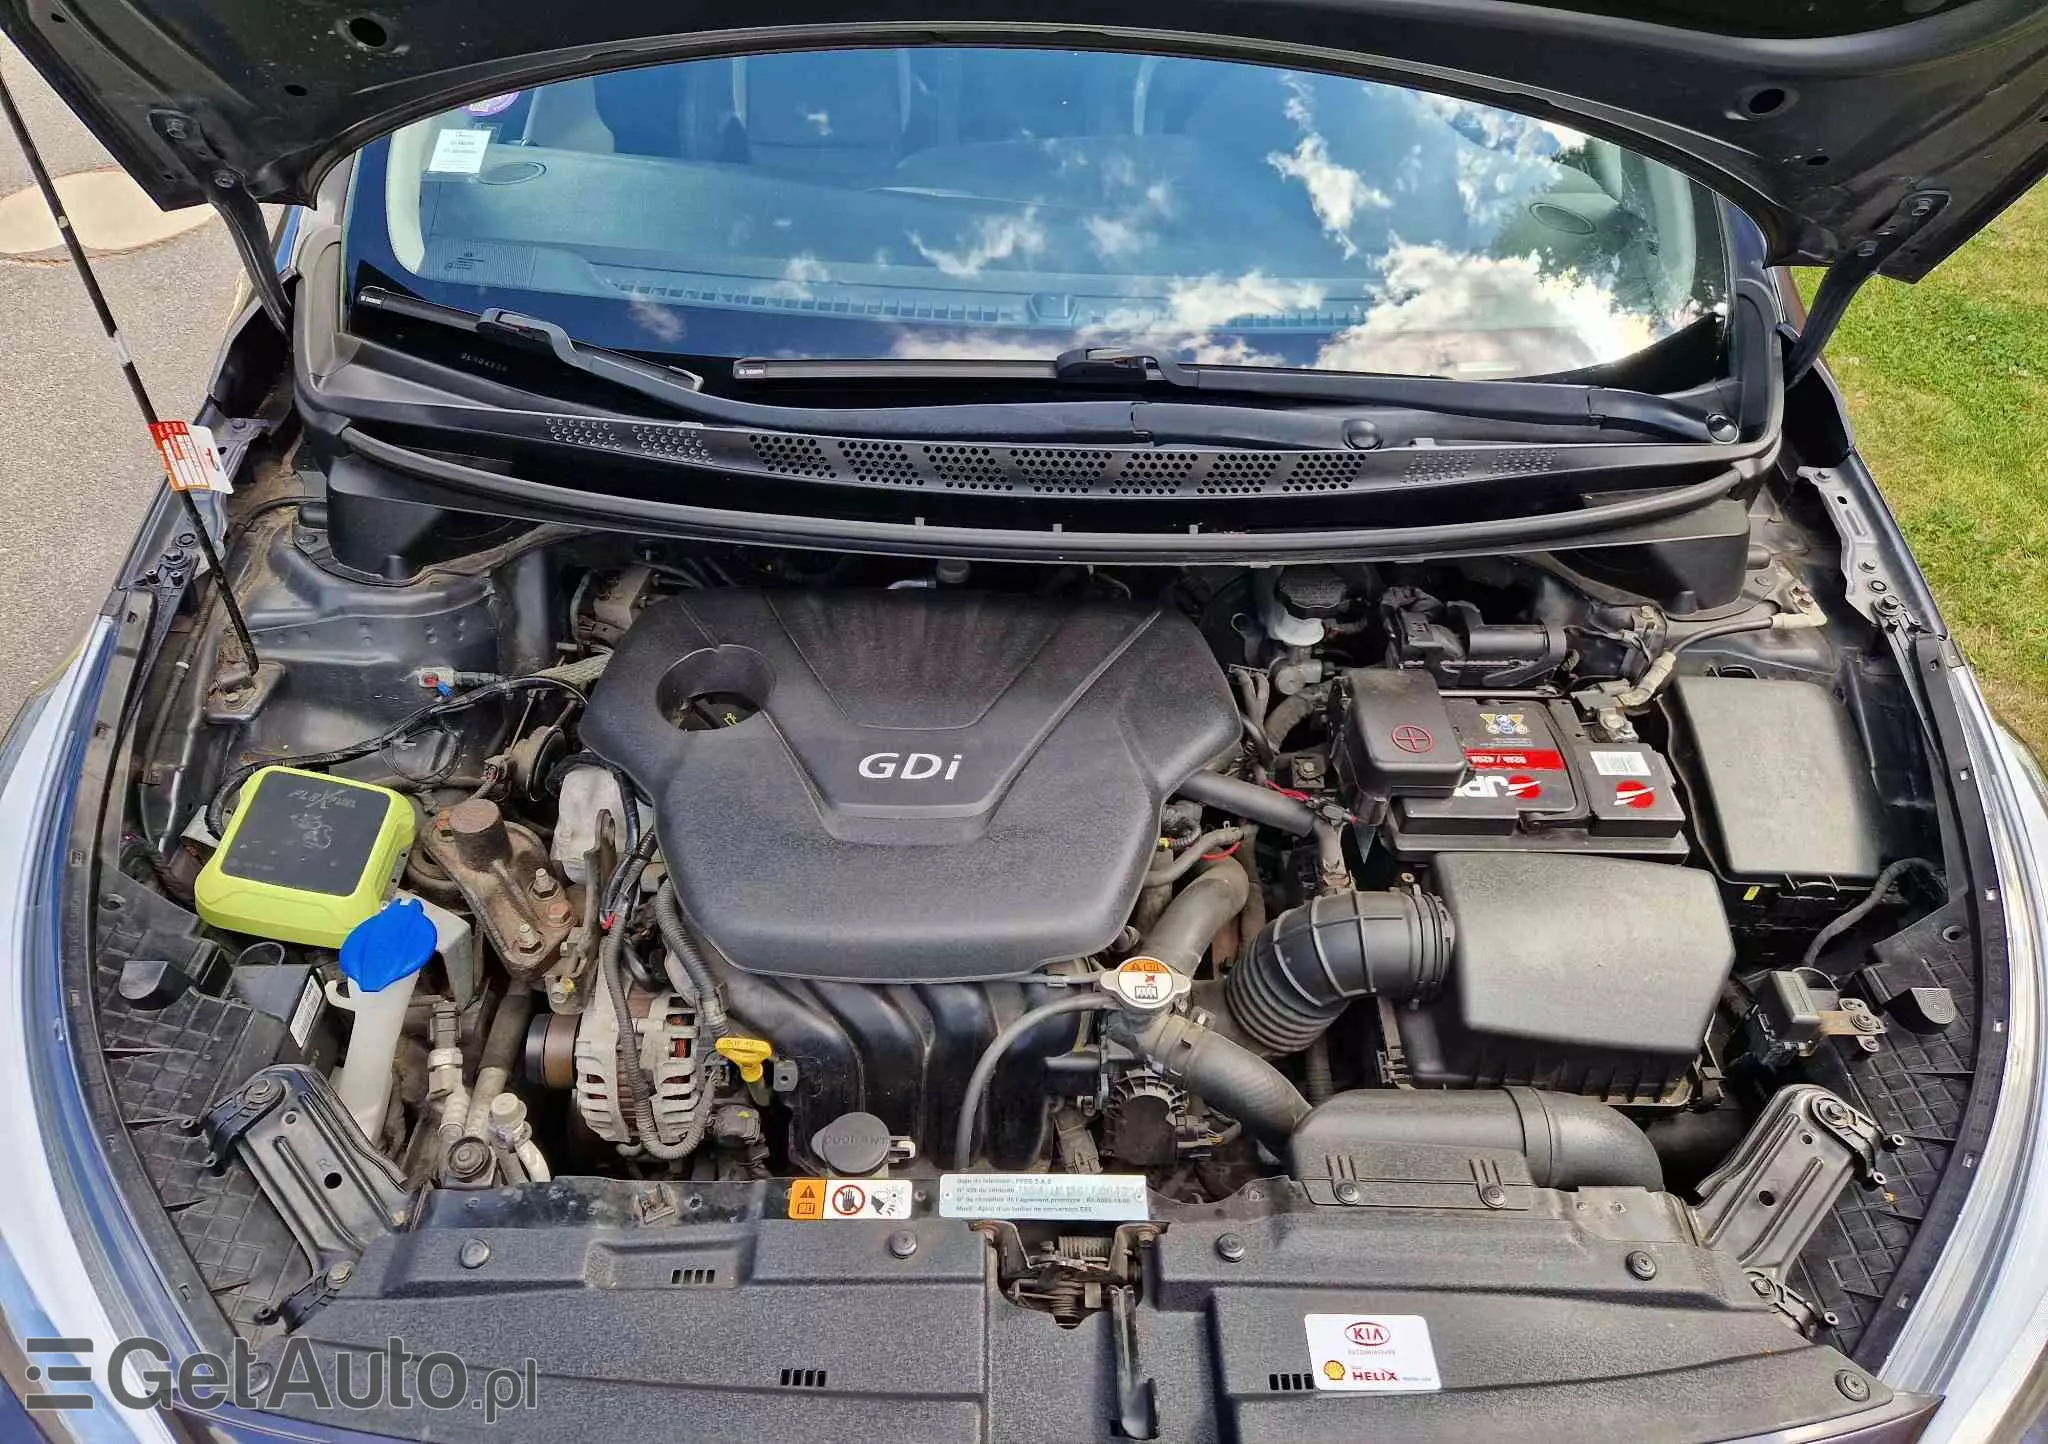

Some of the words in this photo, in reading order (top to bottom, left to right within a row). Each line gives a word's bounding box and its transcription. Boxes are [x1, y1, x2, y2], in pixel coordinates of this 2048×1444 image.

[858, 752, 962, 780] GDi
[1353, 1327, 1384, 1341] KIA
[1352, 1368, 1398, 1381] HELIX
